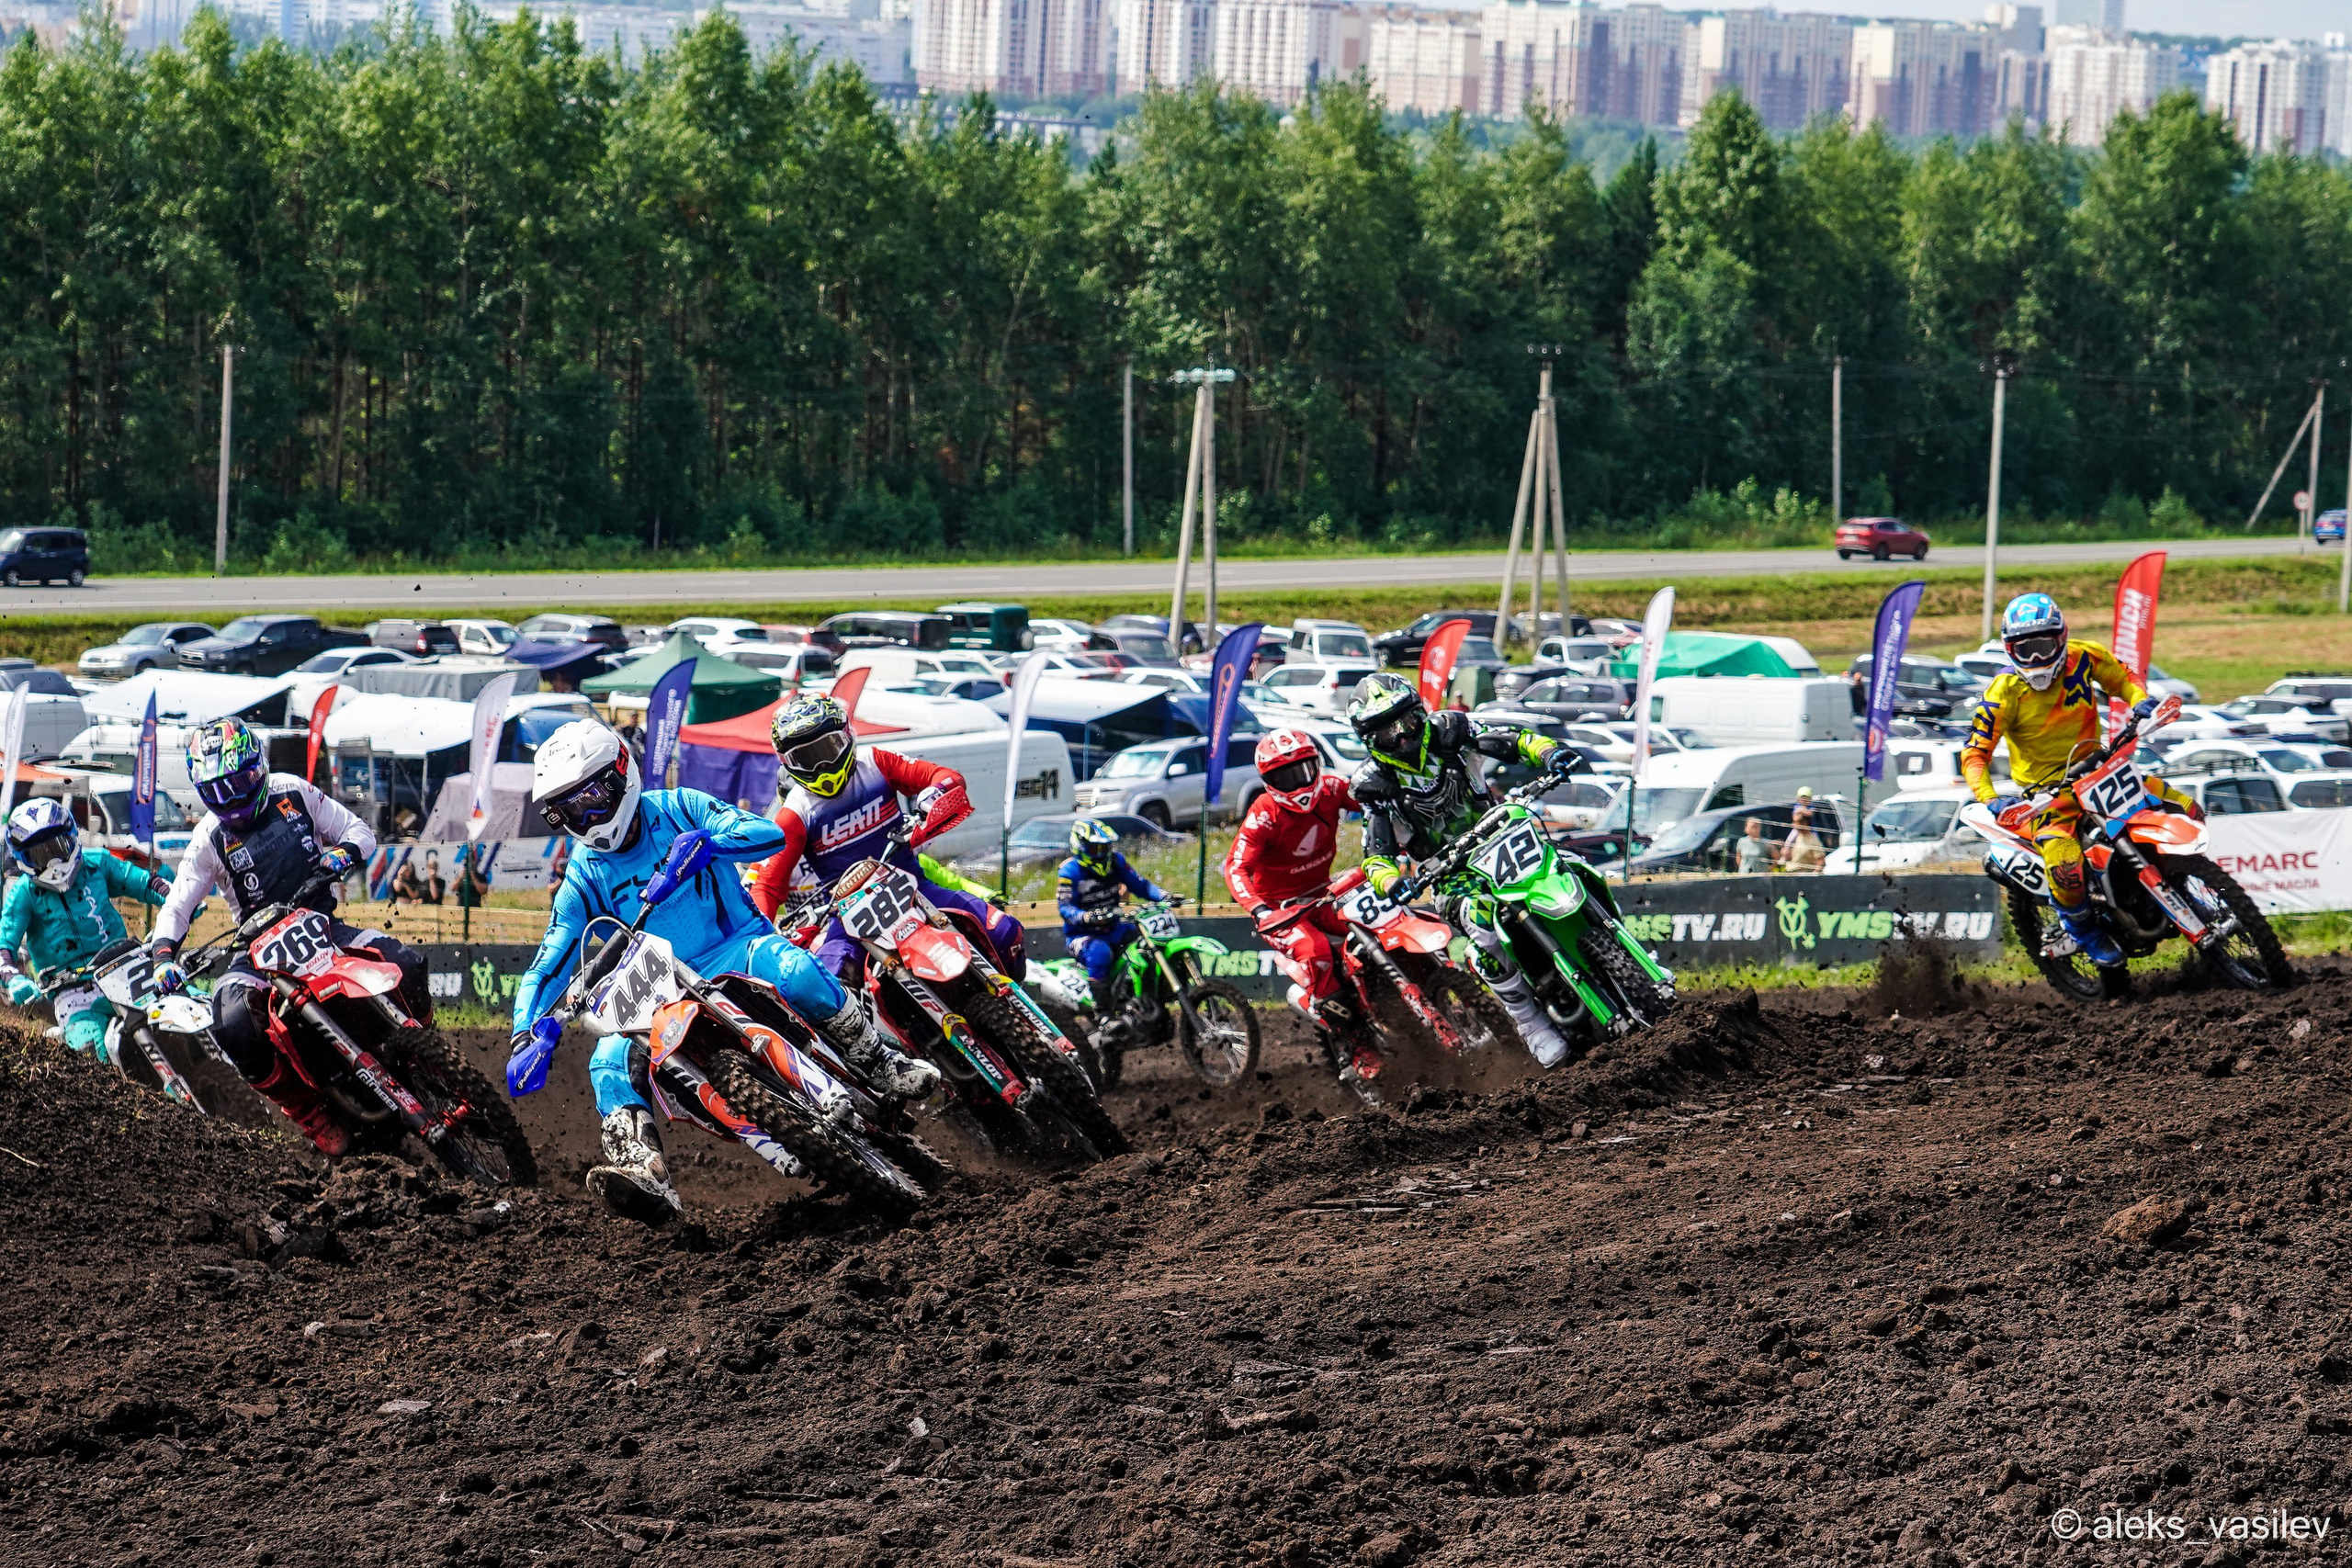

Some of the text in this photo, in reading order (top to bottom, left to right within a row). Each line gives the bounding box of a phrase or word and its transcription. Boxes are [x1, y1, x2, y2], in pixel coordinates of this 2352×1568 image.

[2087, 762, 2142, 814] 125
[821, 795, 884, 846] LEATT
[674, 837, 706, 878] Polisport
[1494, 829, 1543, 890] 42
[2007, 848, 2045, 890] 125
[851, 872, 916, 939] 285
[262, 914, 331, 976] 269
[610, 943, 672, 1030] 444
[516, 1051, 543, 1089] Polisport
